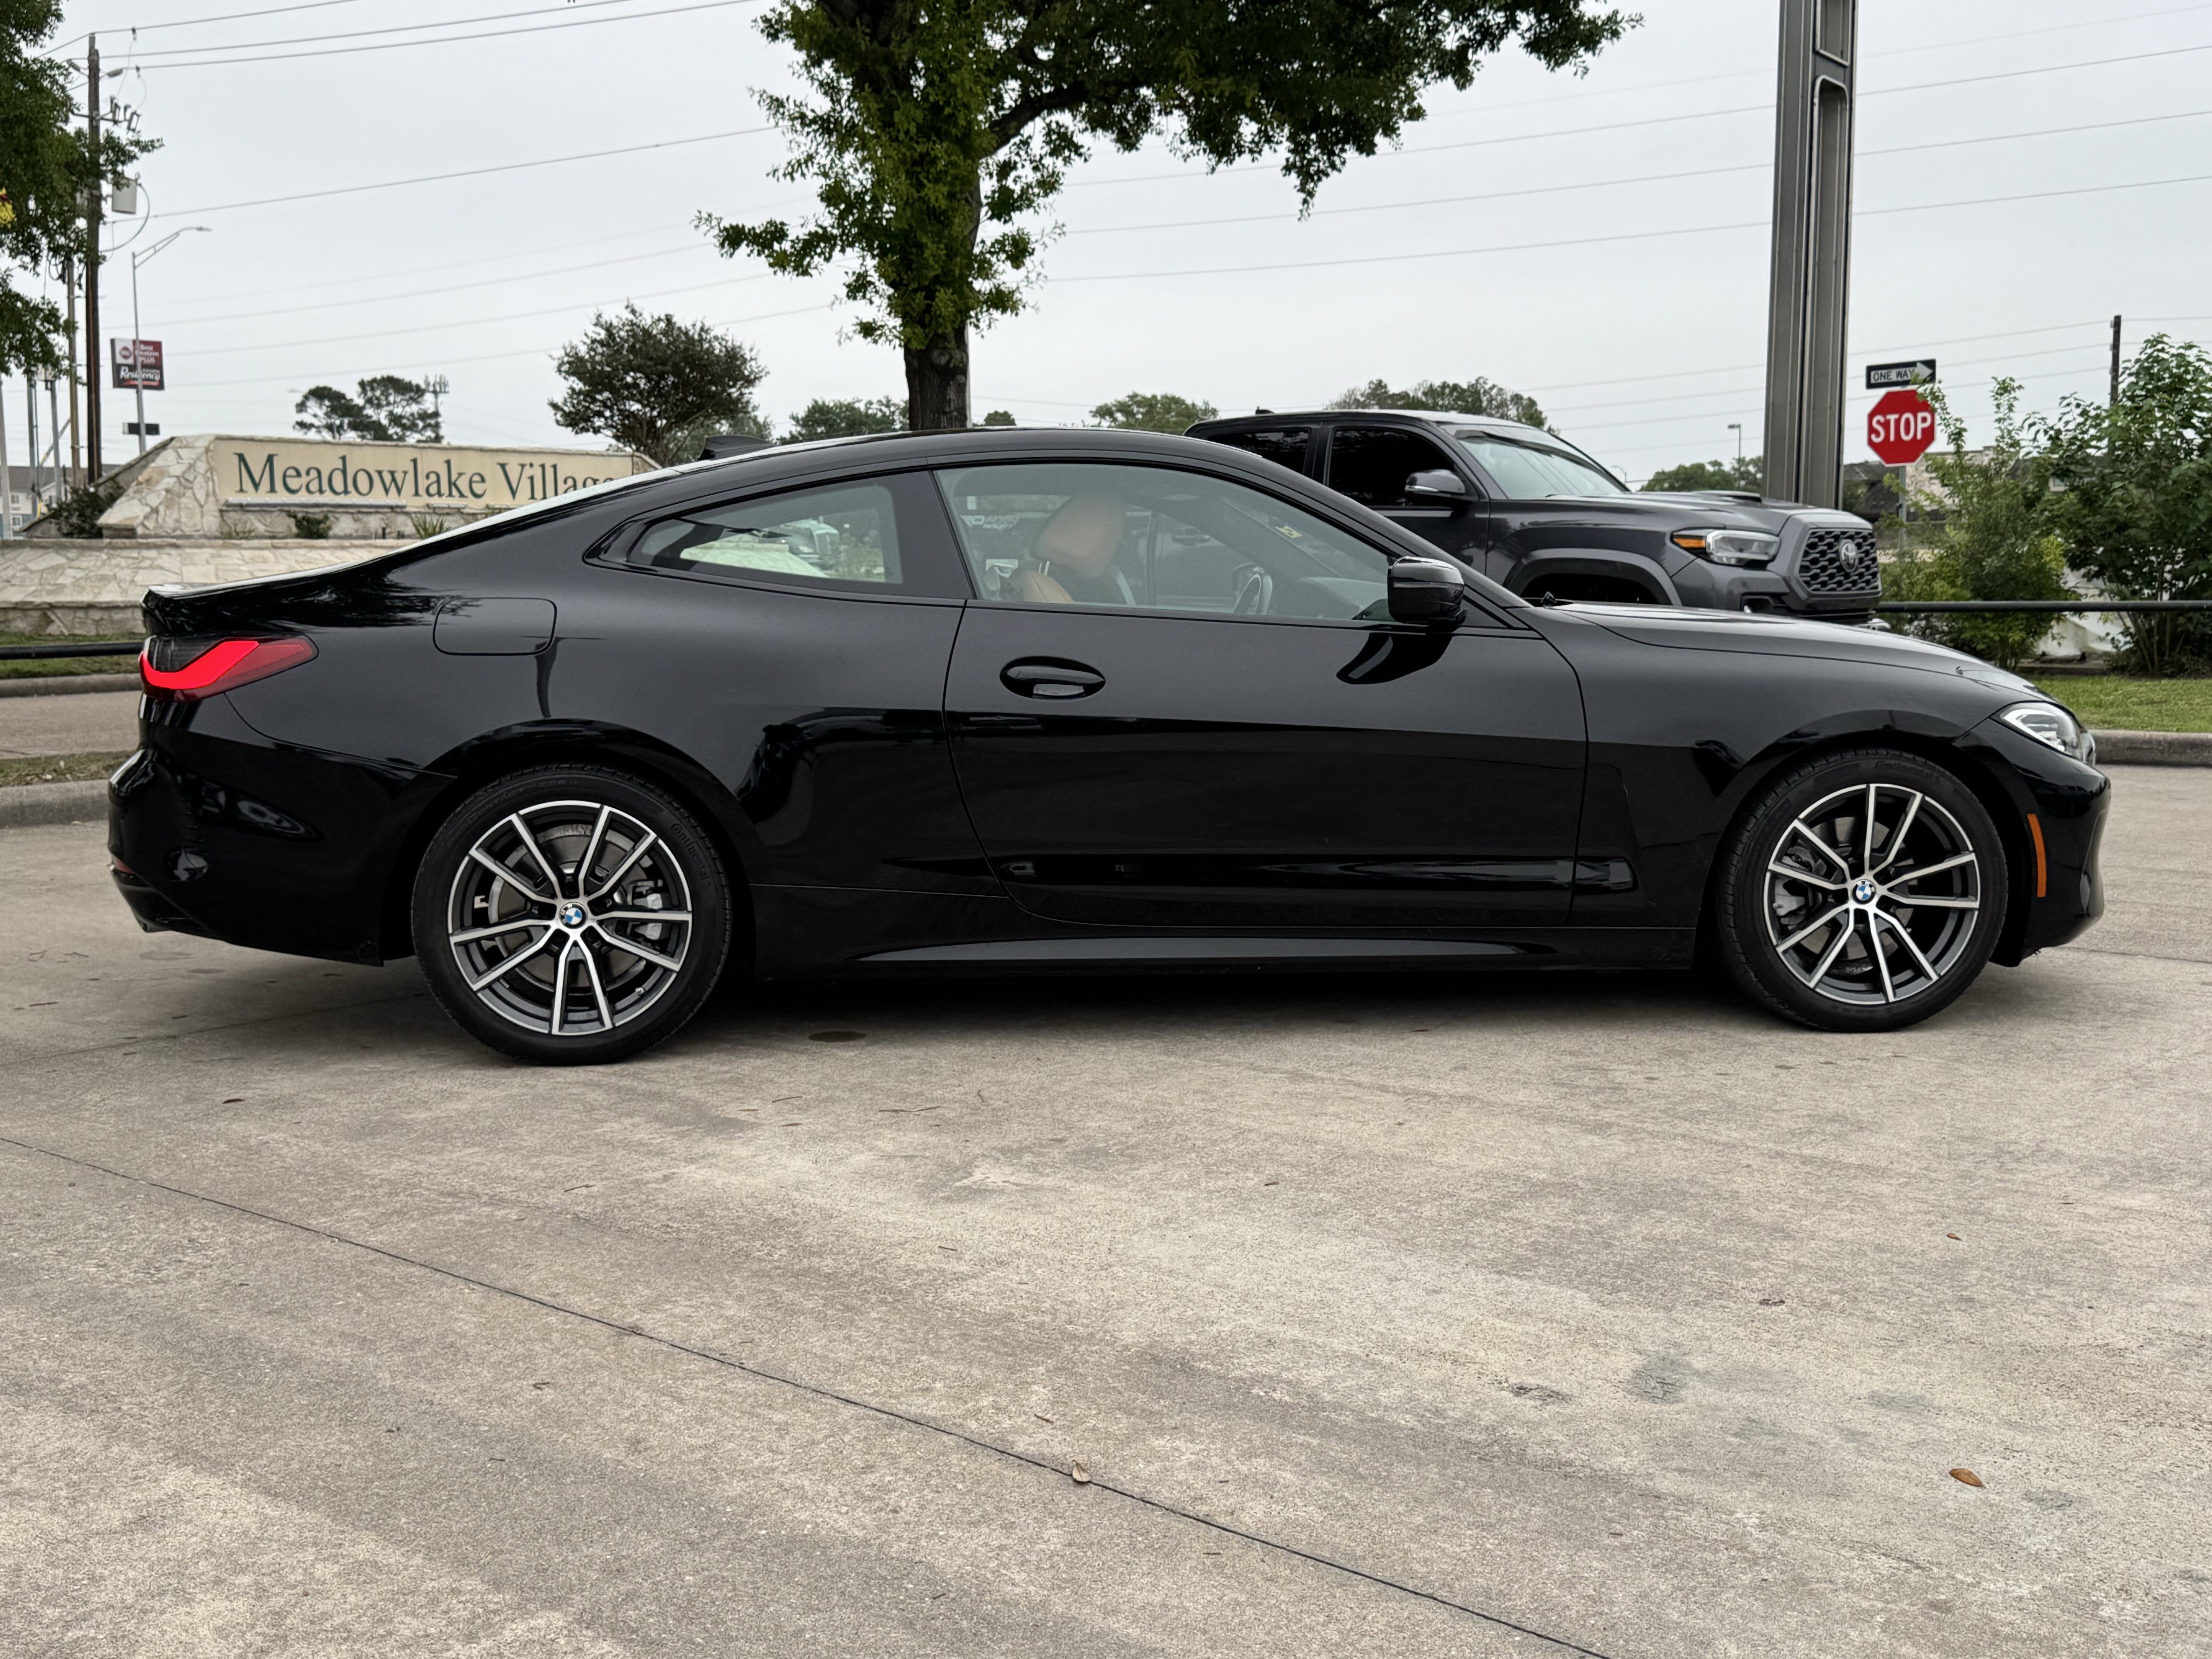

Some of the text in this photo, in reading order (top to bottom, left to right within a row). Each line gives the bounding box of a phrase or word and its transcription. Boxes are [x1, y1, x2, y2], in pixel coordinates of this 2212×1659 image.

[120, 366, 160, 382] Resiency
[1873, 371, 1893, 381] ONE
[1871, 412, 1932, 443] STOP
[233, 452, 486, 499] Meadowlake
[670, 823, 711, 880] Continental
